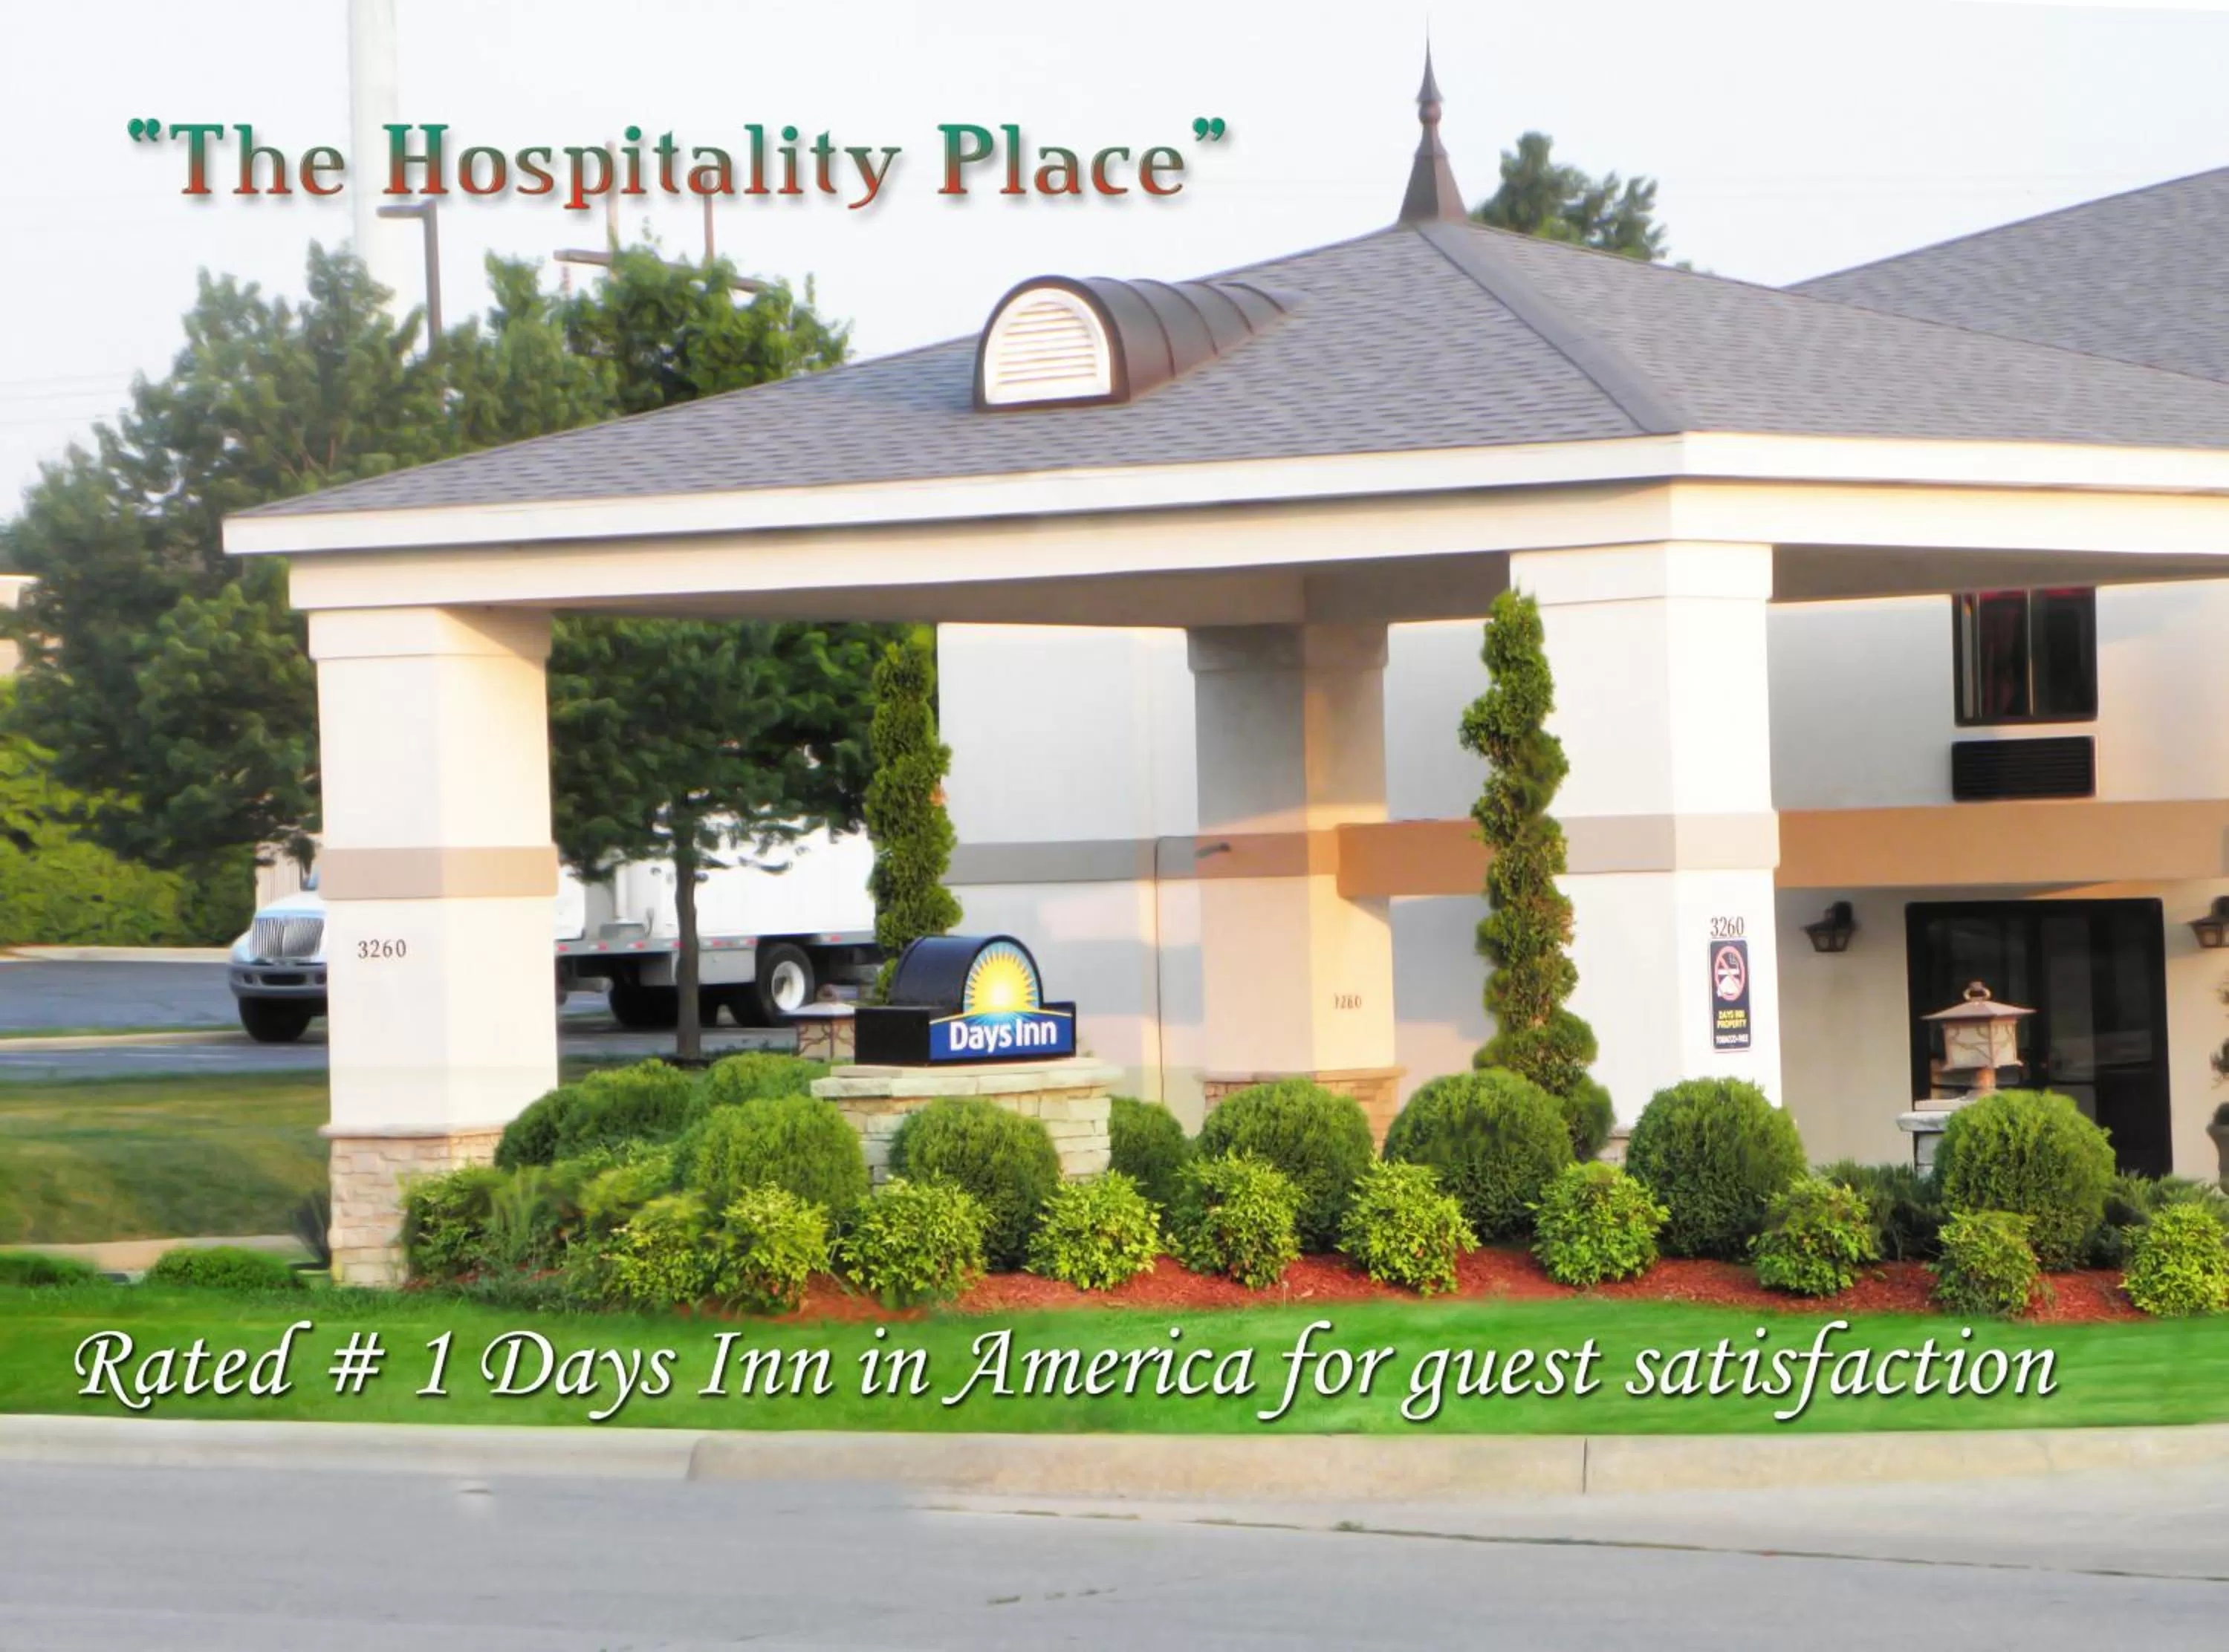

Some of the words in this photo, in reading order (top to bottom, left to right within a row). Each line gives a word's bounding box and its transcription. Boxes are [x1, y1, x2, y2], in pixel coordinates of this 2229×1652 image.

[1710, 916, 1744, 937] 3260
[357, 939, 406, 958] 3260
[950, 1021, 1012, 1053] Days
[1016, 1019, 1057, 1047] Inn
